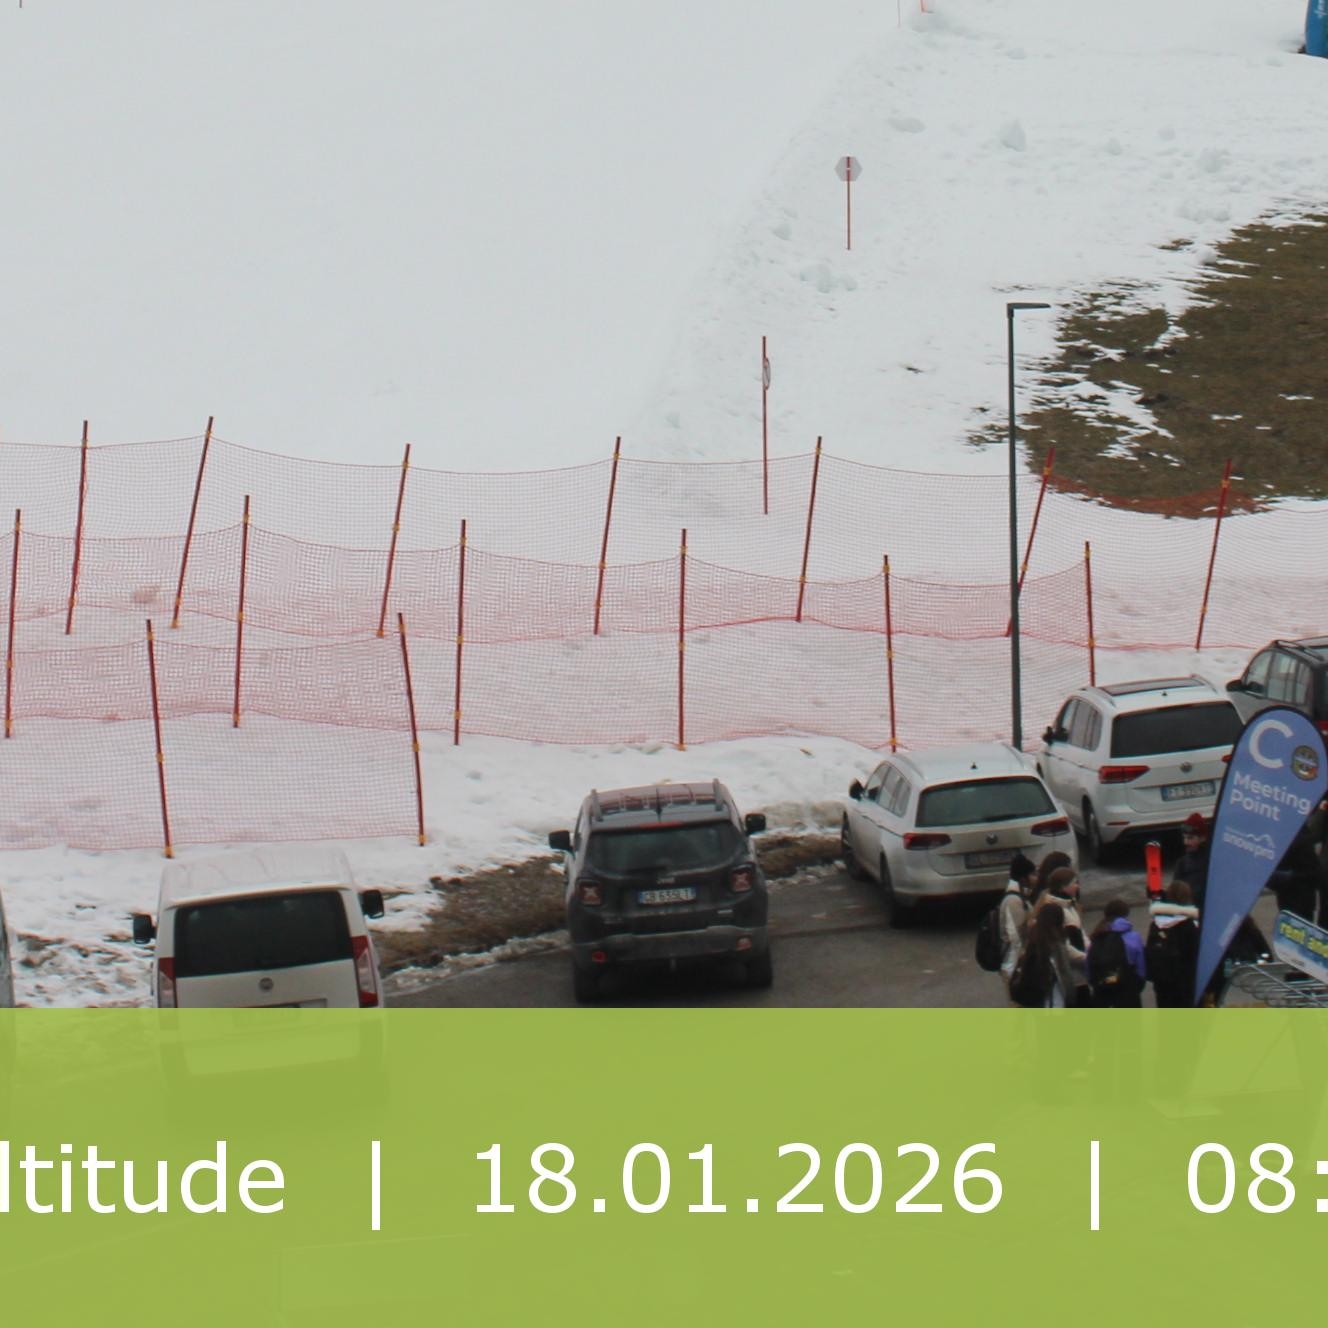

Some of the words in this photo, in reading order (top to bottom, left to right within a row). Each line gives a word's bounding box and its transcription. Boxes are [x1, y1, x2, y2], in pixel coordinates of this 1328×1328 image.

[1249, 719, 1294, 768] C
[1229, 788, 1281, 821] Point
[1233, 771, 1312, 816] Meeting
